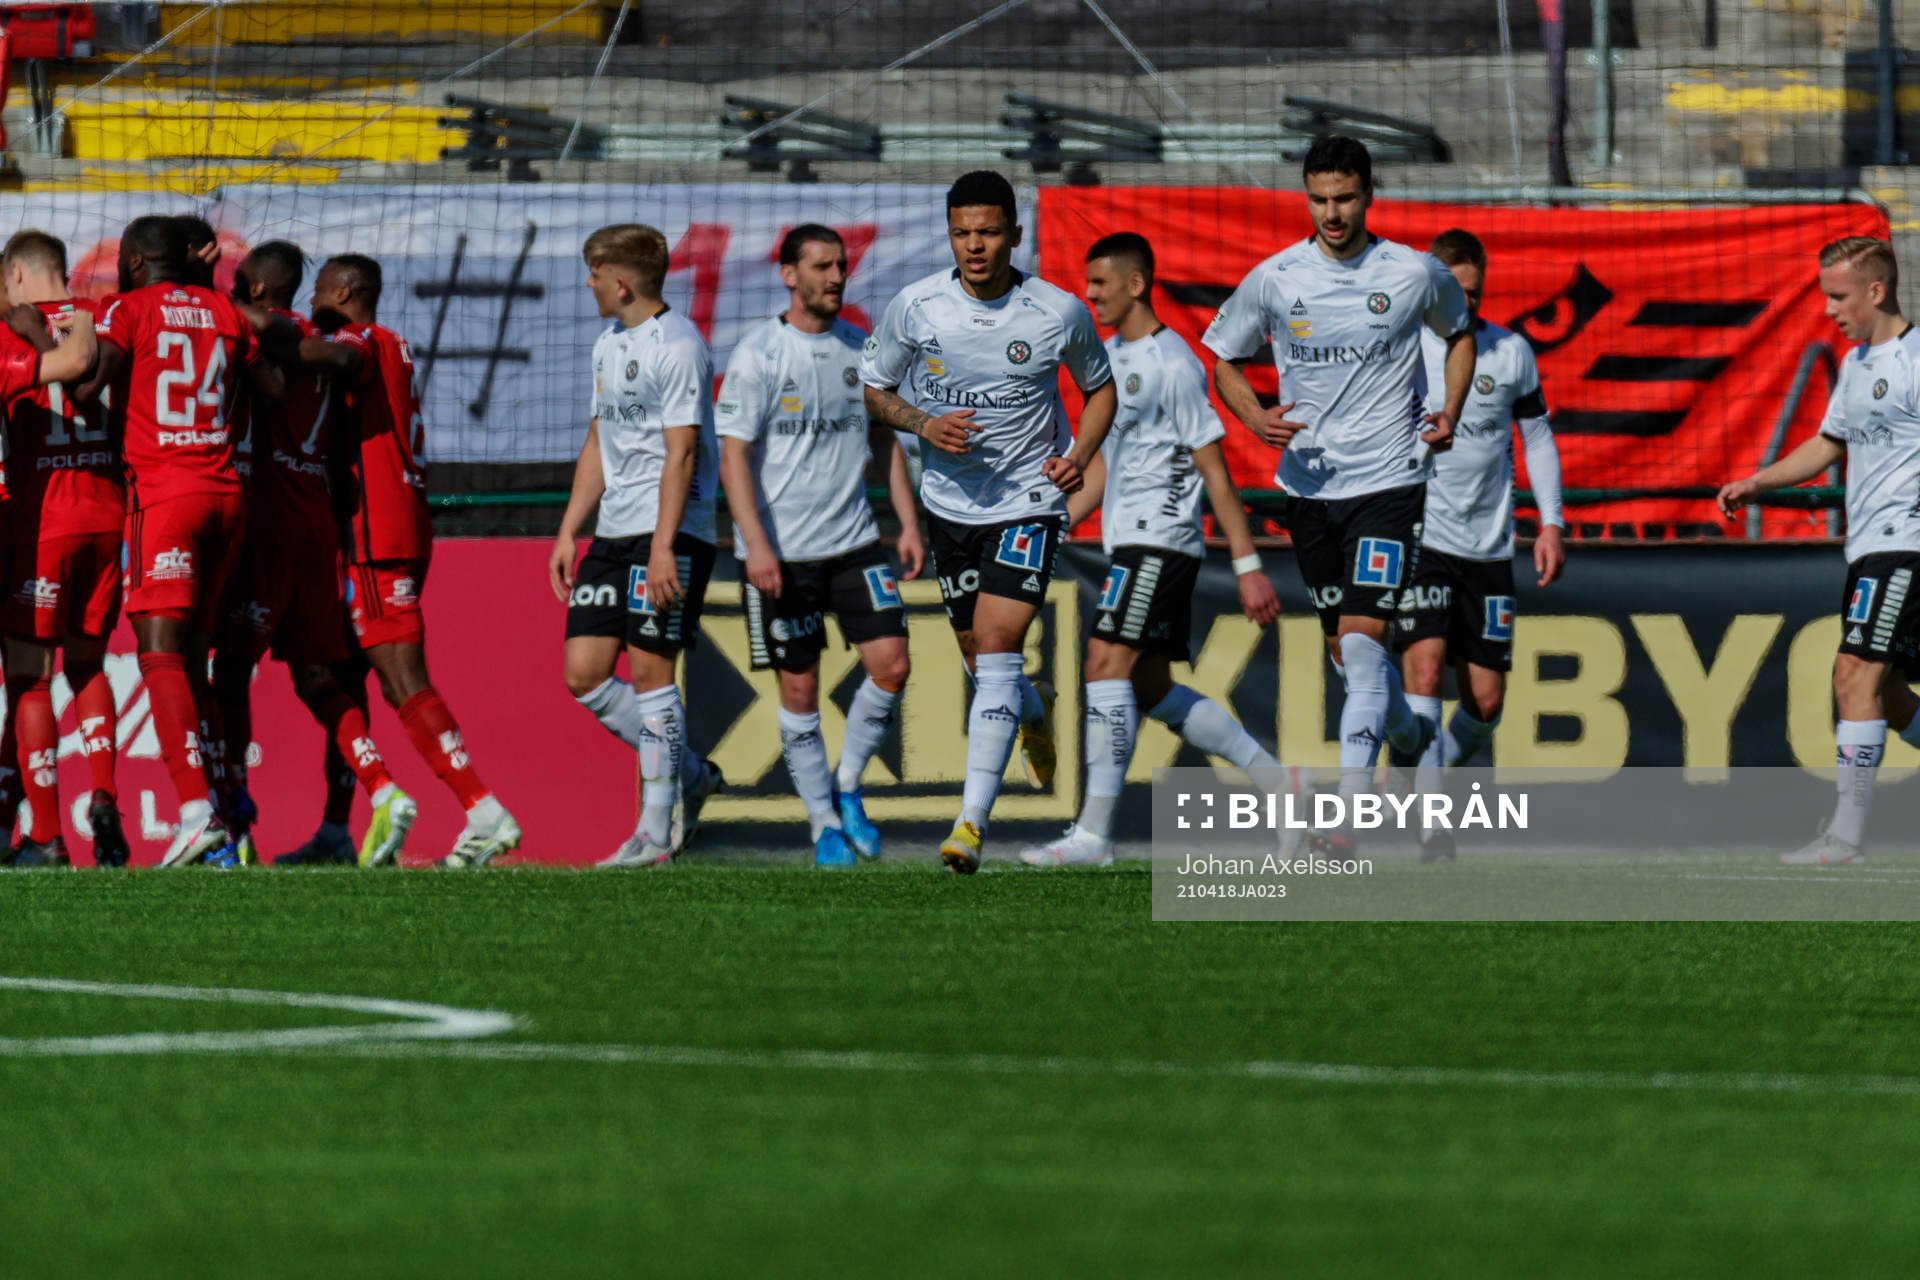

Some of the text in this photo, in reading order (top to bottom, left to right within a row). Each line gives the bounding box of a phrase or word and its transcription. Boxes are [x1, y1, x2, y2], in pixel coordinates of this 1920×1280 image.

[1289, 343, 1364, 363] BEHRN
[156, 330, 228, 430] 24
[925, 379, 998, 409] BEHRN
